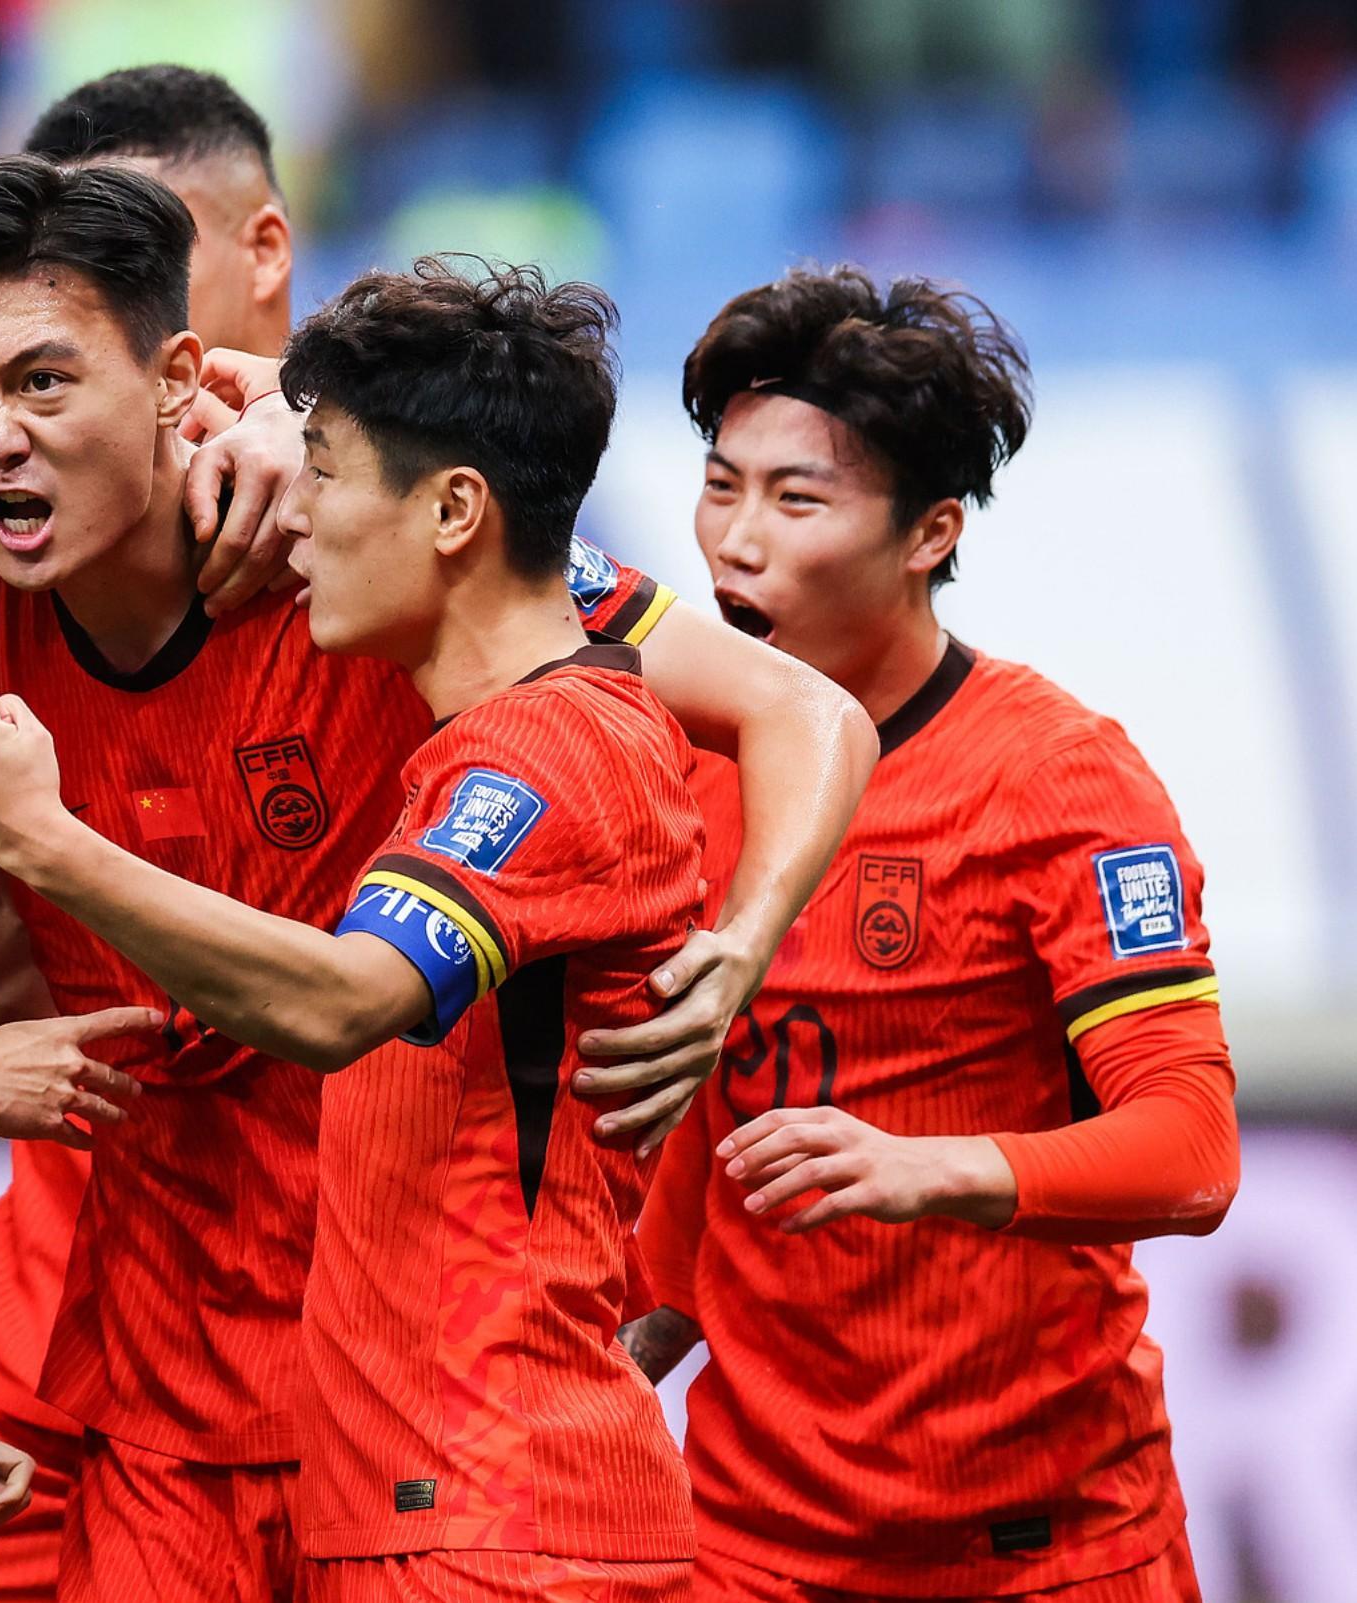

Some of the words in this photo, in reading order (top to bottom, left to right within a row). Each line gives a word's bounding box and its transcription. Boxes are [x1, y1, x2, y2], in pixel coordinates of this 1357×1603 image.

[243, 744, 304, 774] CFA
[471, 784, 521, 815] FOOTBALL
[451, 814, 472, 830] the
[461, 797, 514, 830] UNITES
[864, 864, 917, 885] CFA
[1116, 861, 1169, 883] FOOTBALL
[1120, 876, 1171, 903] UNITES
